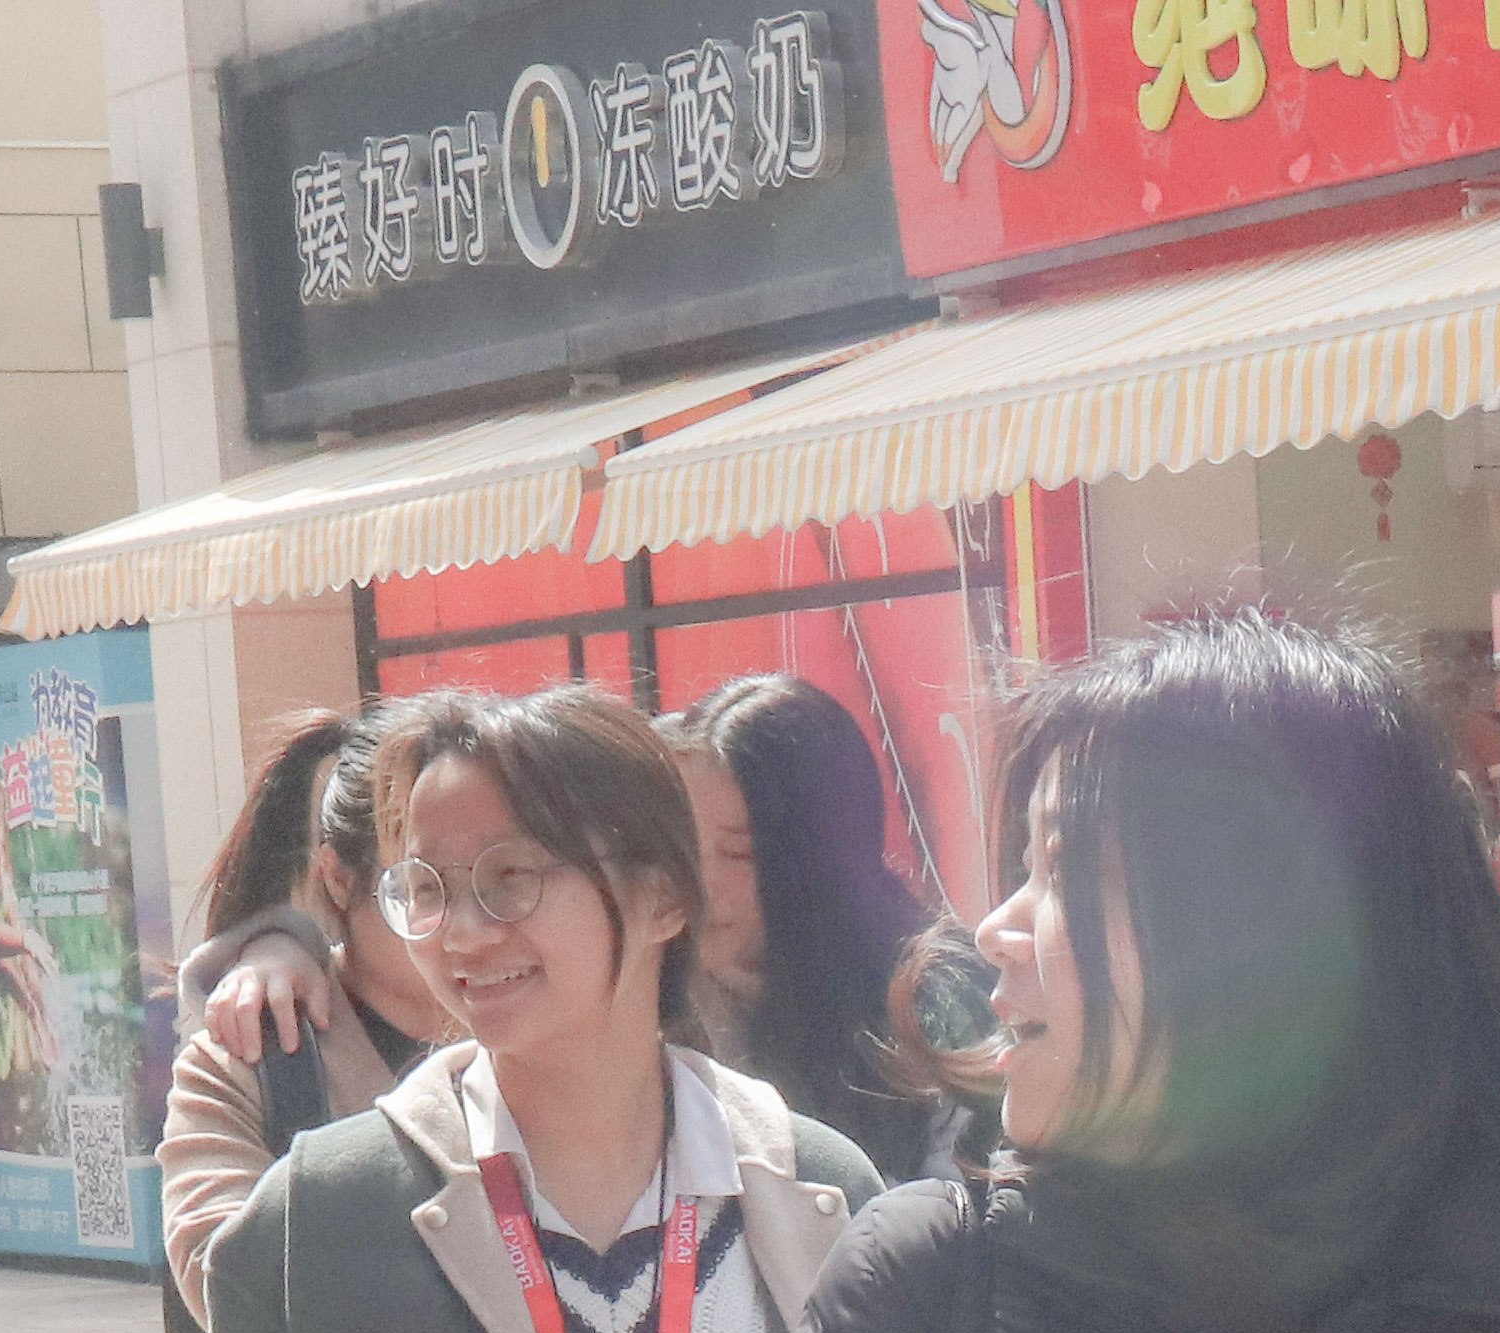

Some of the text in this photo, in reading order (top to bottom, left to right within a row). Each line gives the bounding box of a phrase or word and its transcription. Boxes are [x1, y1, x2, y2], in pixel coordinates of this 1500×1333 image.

[294, 11, 827, 304] 臻好时 冻酸奶
